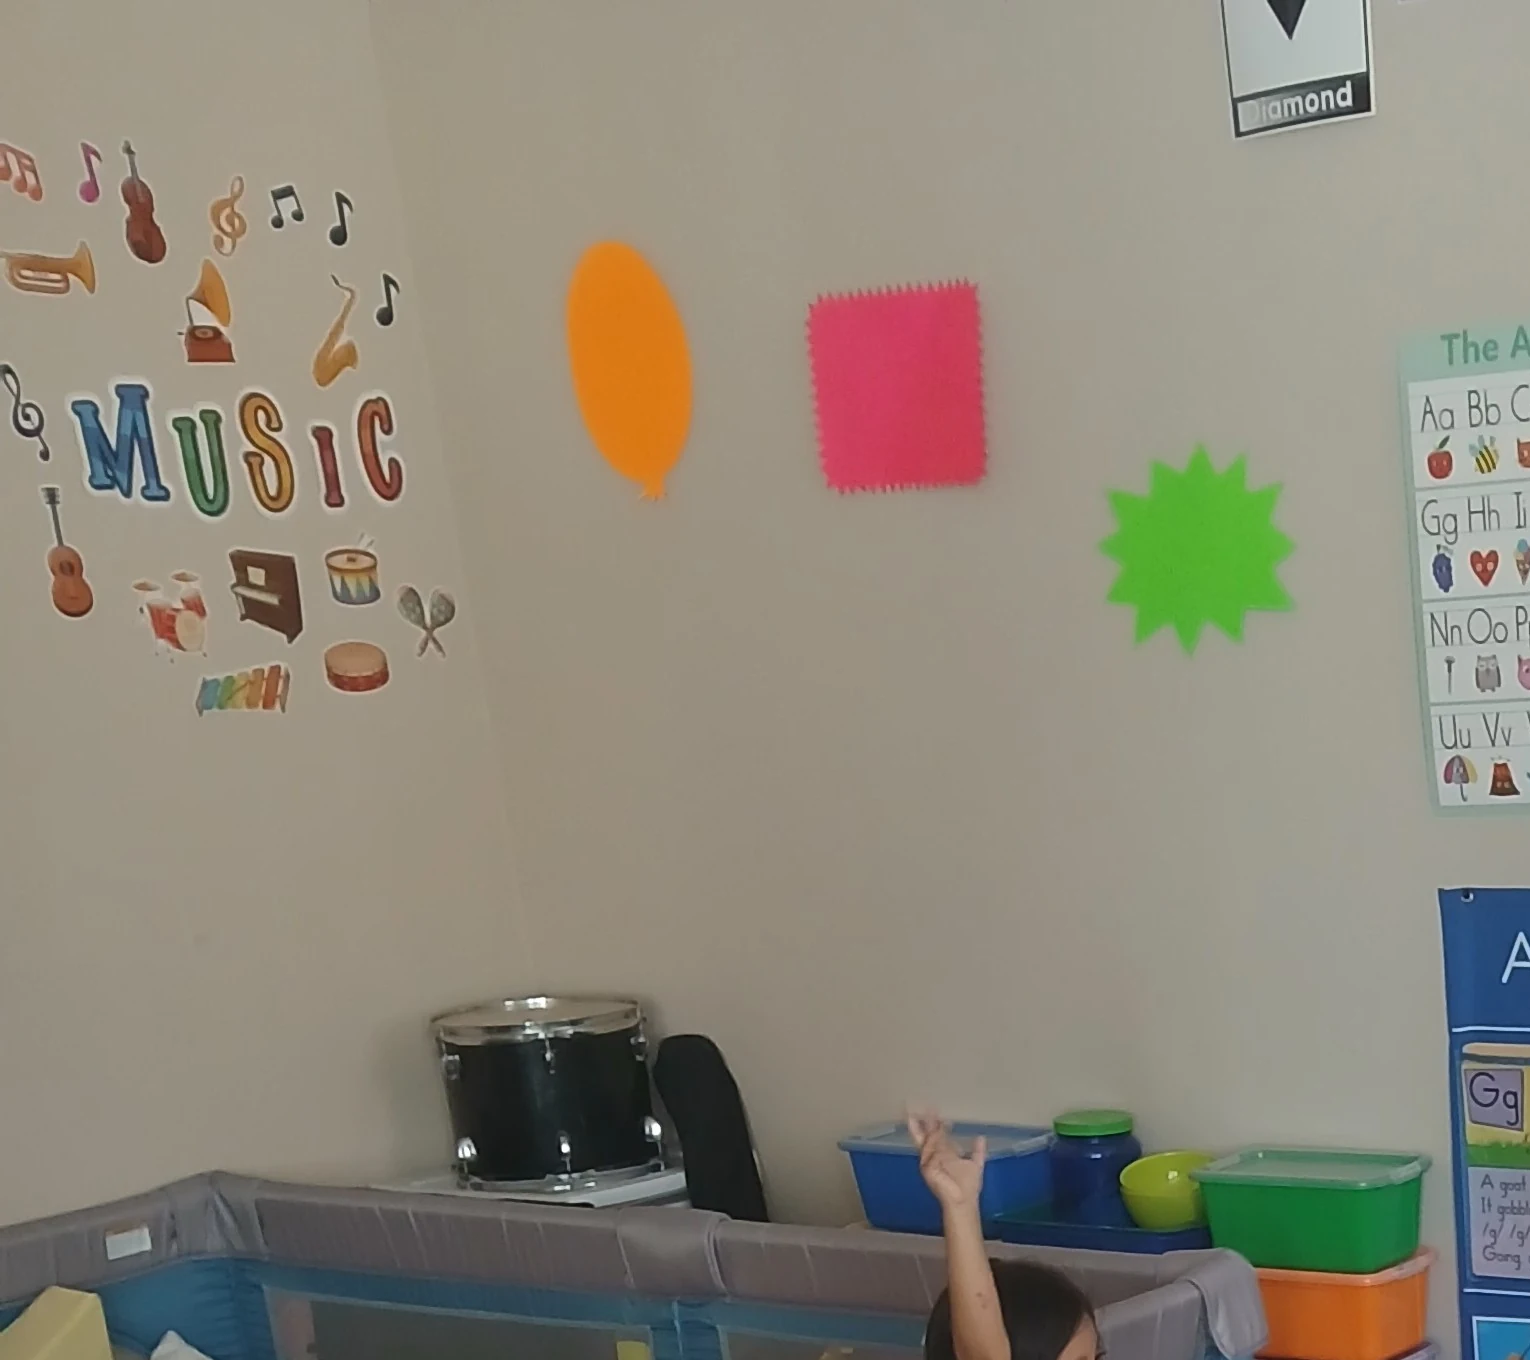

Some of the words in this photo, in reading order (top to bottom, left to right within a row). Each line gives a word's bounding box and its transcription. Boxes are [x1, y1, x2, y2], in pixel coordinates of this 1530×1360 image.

[1241, 80, 1353, 123] Diamond
[1441, 328, 1499, 367] The
[1420, 395, 1455, 432] Aa
[1467, 390, 1500, 429] Bb
[70, 383, 403, 517] MUSIC
[1421, 499, 1458, 545] Gg
[1467, 495, 1500, 533] Hh
[1514, 491, 1528, 530] Ii
[1430, 612, 1463, 647] Nn
[1467, 608, 1508, 645] Oo
[1439, 714, 1471, 750] Uu
[1483, 712, 1512, 748] Vv
[1468, 1071, 1520, 1125] Gg
[1480, 1174, 1494, 1189] A
[1500, 1176, 1526, 1198] goat
[1481, 1198, 1492, 1213] It
[1482, 1222, 1503, 1245] /g/
[1509, 1223, 1530, 1247] /g/
